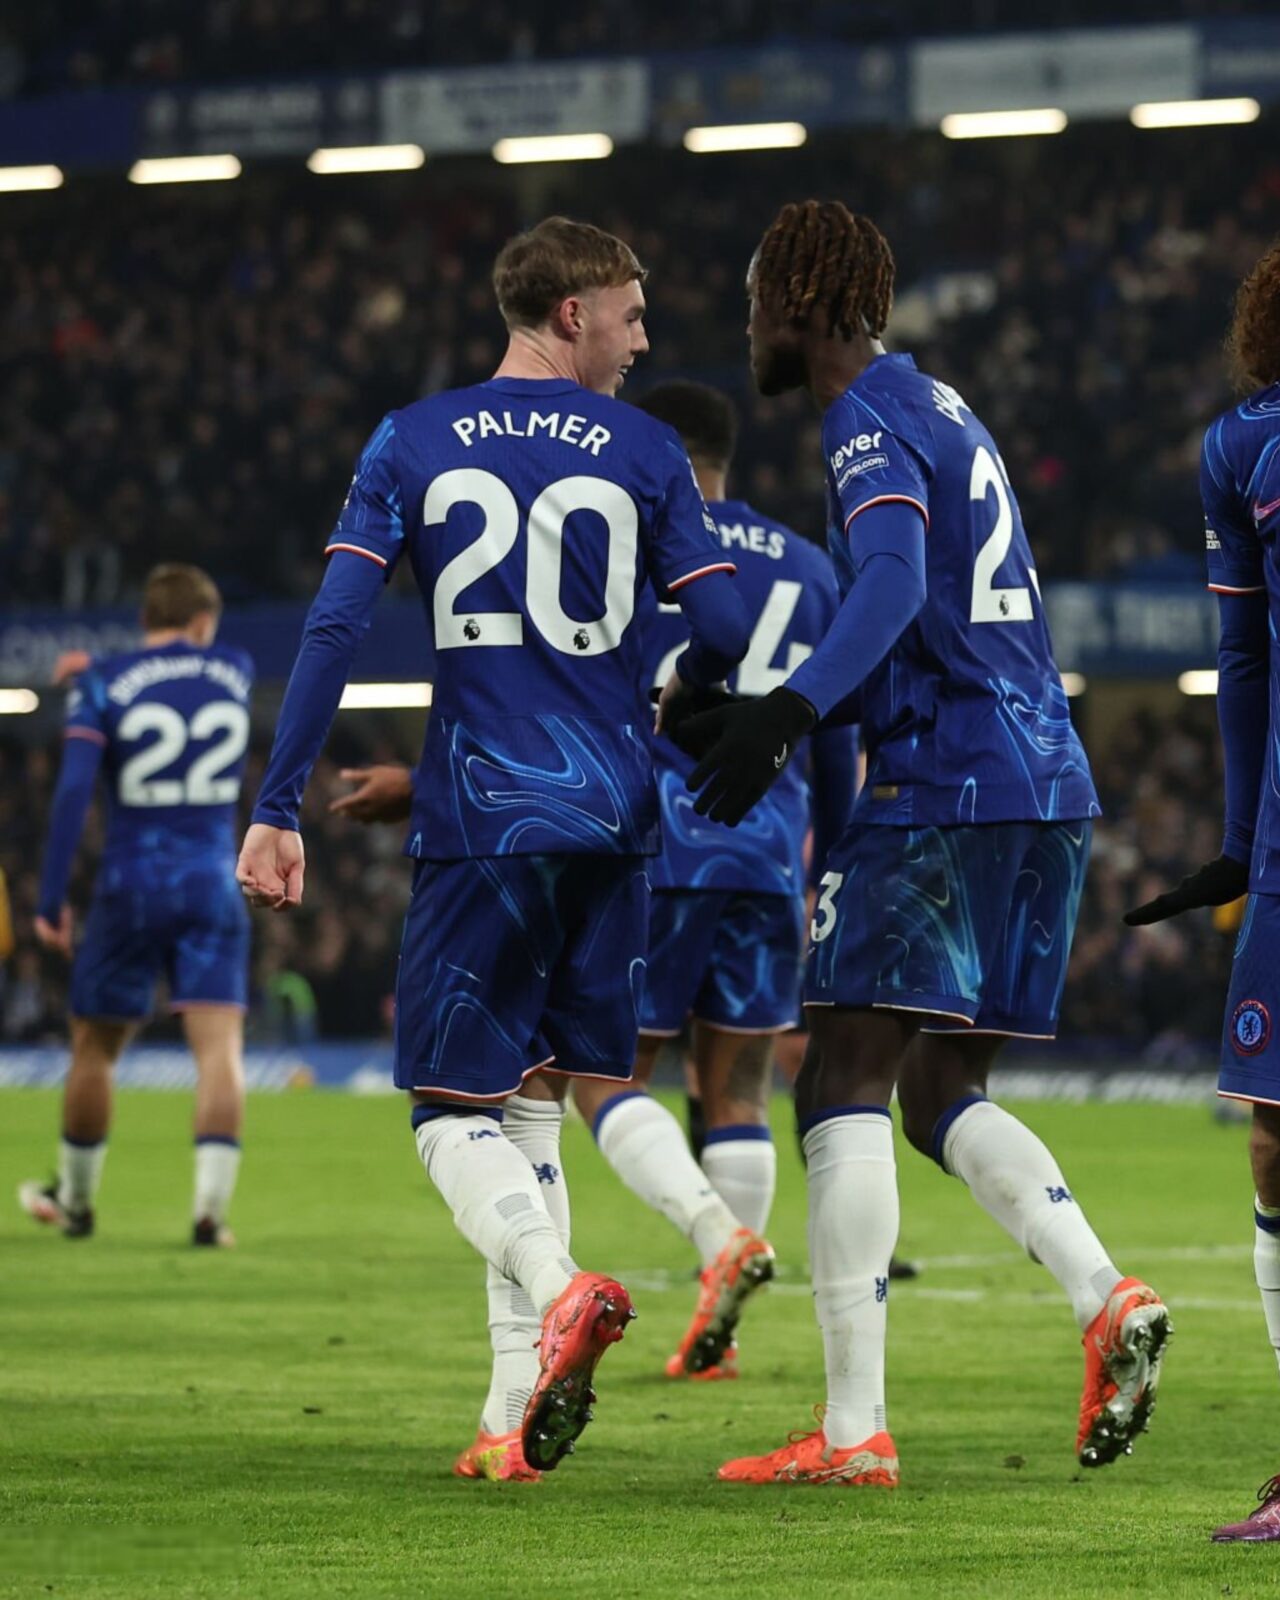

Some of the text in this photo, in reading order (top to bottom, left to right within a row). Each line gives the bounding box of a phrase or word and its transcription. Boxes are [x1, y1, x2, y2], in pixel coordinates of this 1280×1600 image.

[452, 410, 612, 456] PALMER
[423, 467, 638, 657] 20
[719, 523, 786, 560] MES
[970, 446, 1042, 623] 2
[117, 702, 249, 807] 22
[811, 871, 844, 942] 3
